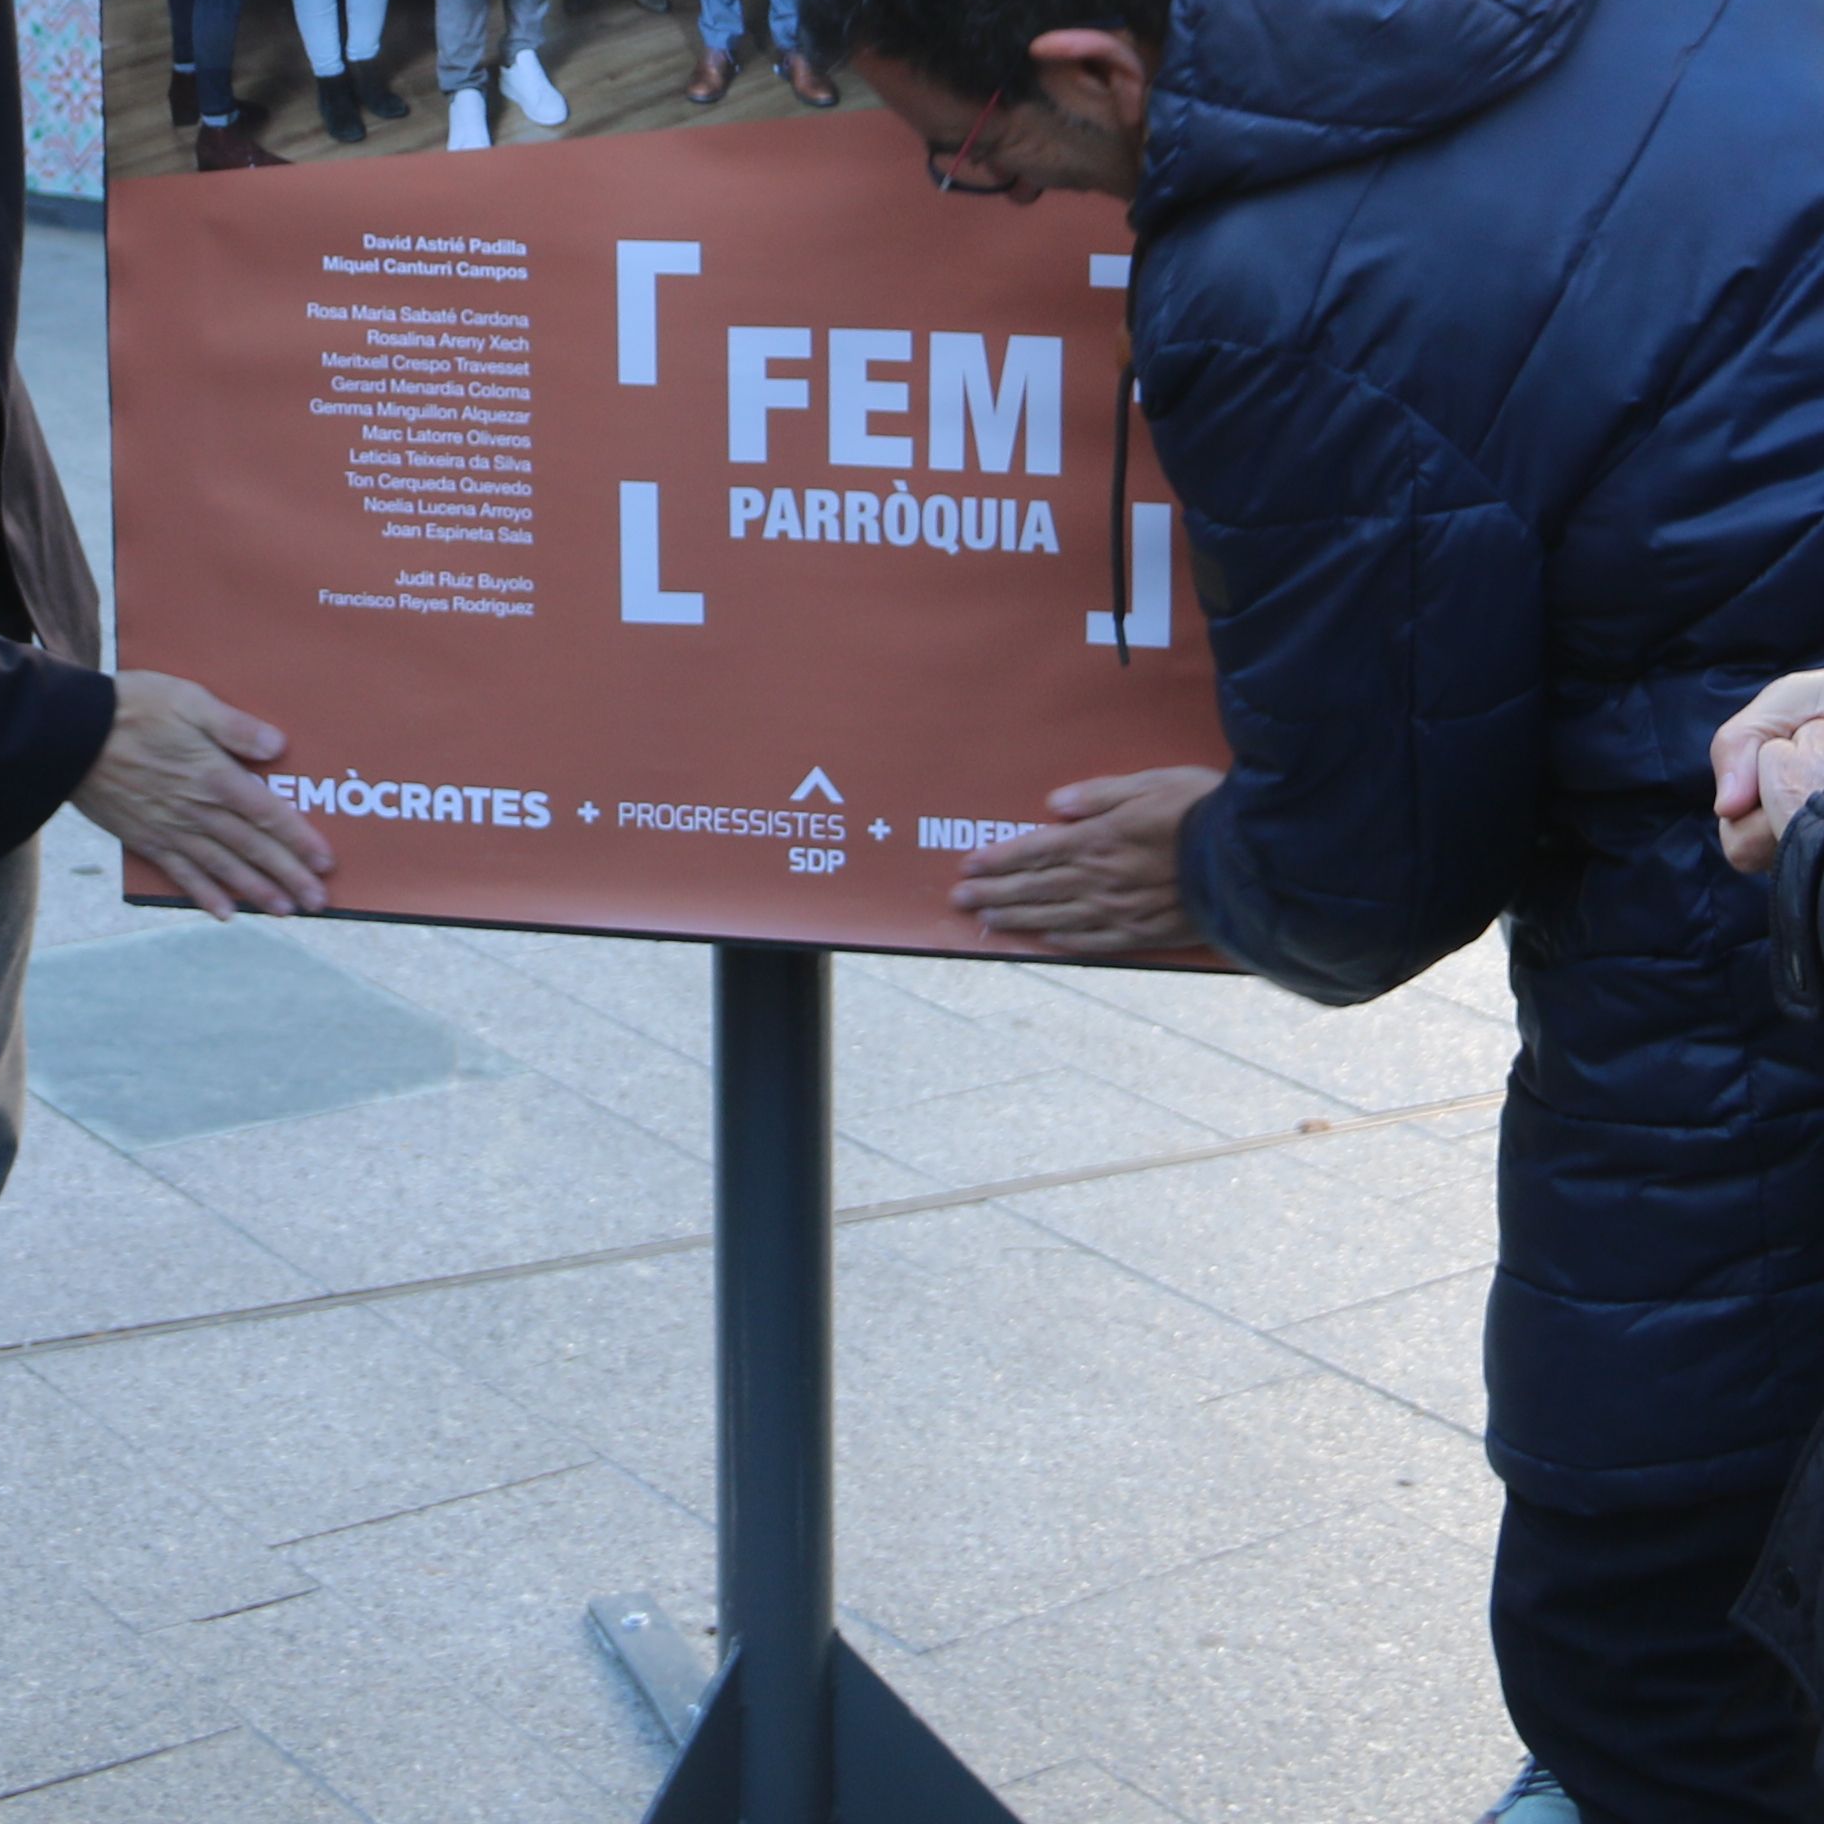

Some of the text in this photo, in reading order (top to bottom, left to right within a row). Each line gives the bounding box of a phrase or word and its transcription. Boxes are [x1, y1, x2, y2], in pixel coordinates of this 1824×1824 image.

[363, 233, 527, 256] David Astrié Padilla
[323, 256, 528, 281] Miquel Canturri Campos
[307, 303, 529, 328] Rosa Maria Sabaté Cardona
[367, 329, 529, 352] Rosalina Areny Xech
[322, 352, 529, 376] Meritxell Crespo Travesset
[332, 376, 386, 393] Gerard
[469, 382, 530, 400] Coloma
[310, 398, 373, 416] Gemma
[462, 405, 530, 425] Alquezar
[728, 326, 1062, 475] FEM
[363, 425, 531, 448] Marc Latorre Oliveros
[406, 450, 465, 468] Teixeira
[469, 454, 490, 470] da
[493, 455, 531, 472] Silva
[345, 471, 532, 496] Ton Cerqueda Quevedo
[364, 496, 532, 522] Noelia Lucena Arroyo
[729, 479, 1059, 555] PARRÒQUIA
[382, 521, 533, 544] Joan Espineta Sala
[395, 569, 534, 592] Judit Ruiz Buyolo
[319, 589, 395, 609] Francisco
[399, 594, 449, 613] Reyes
[266, 767, 550, 829] EMÒCRATES
[618, 802, 845, 841] PROGRESSISTES
[789, 848, 845, 873] SDP
